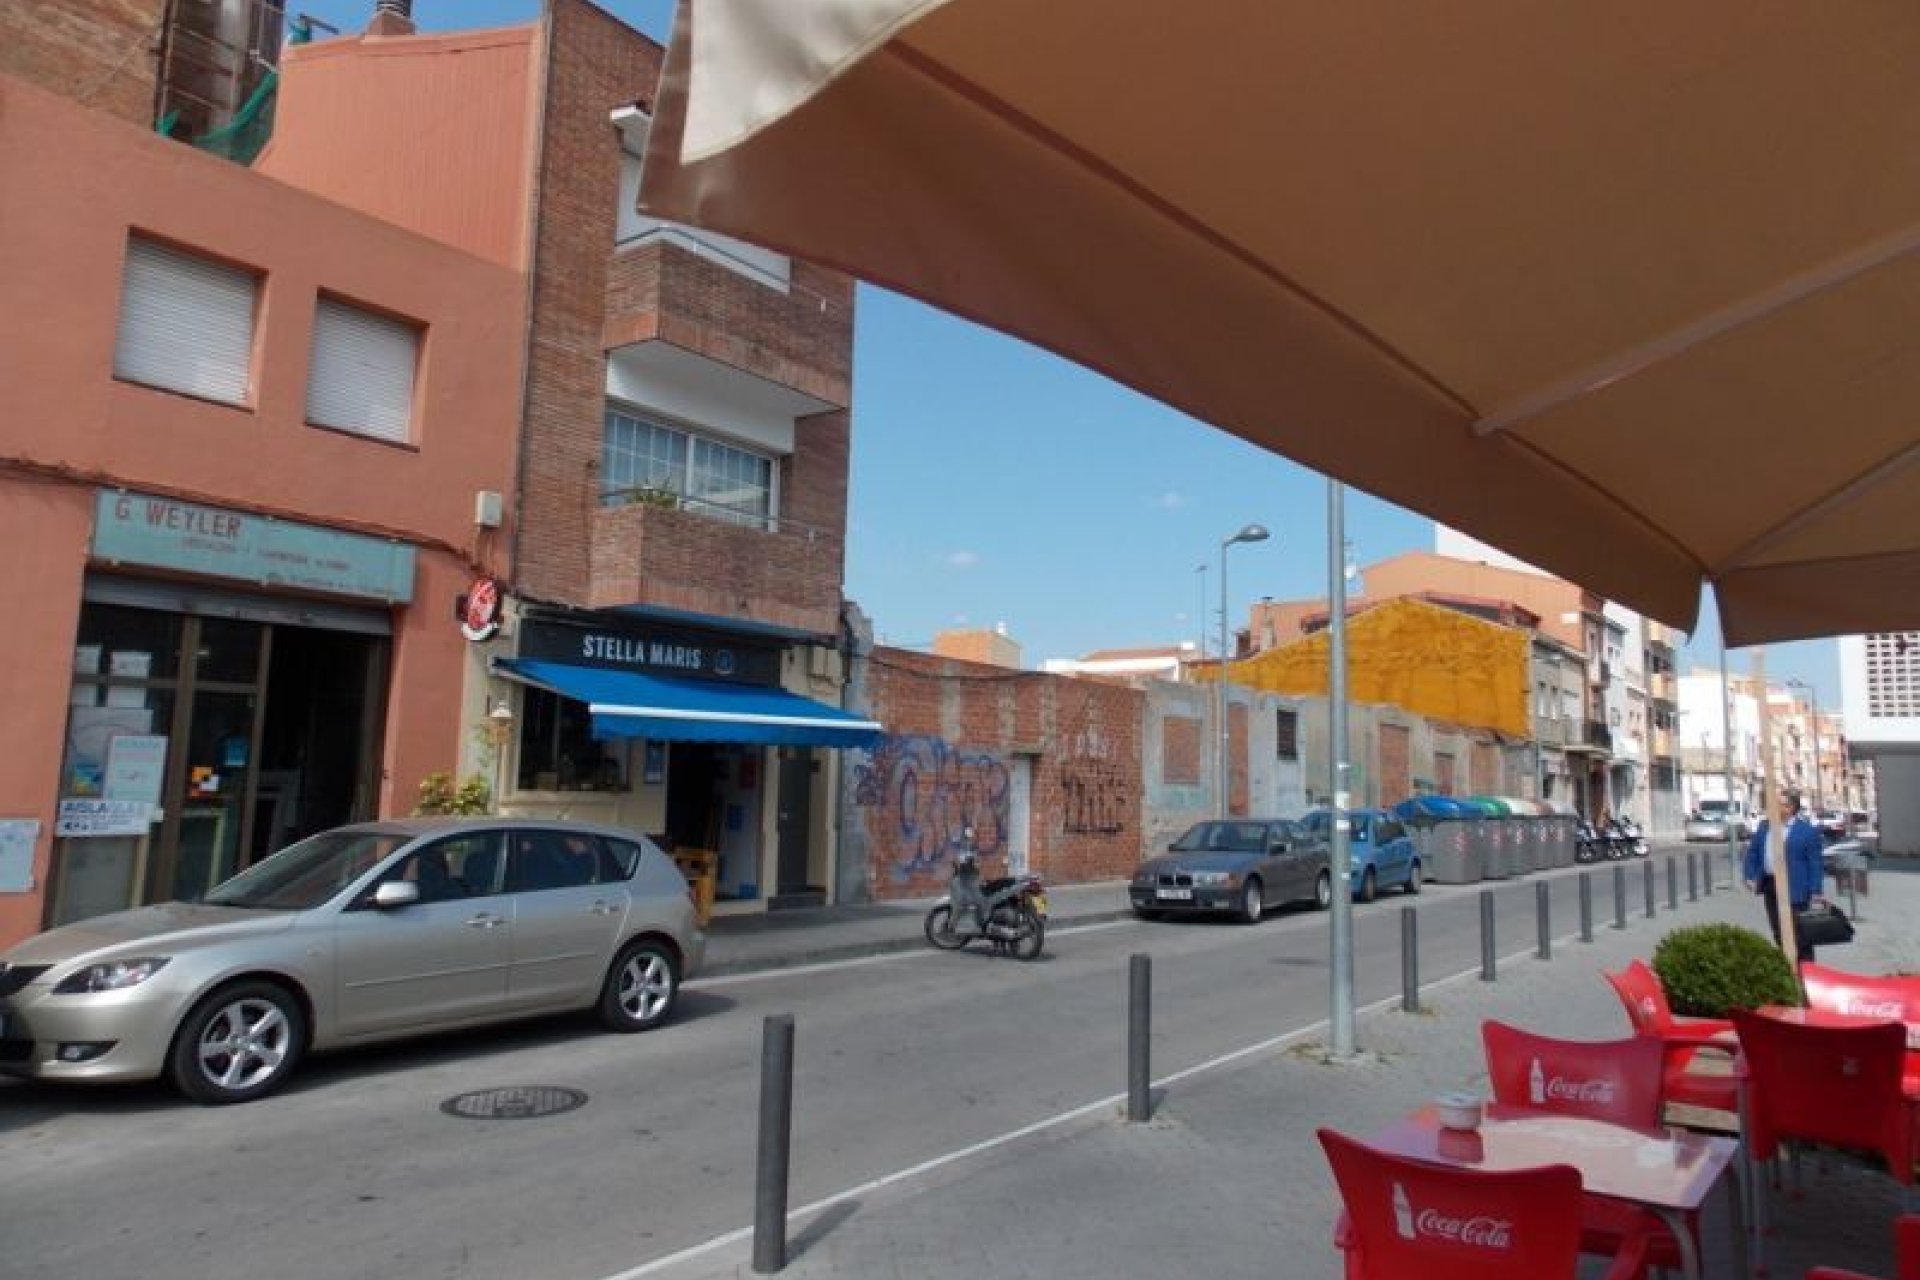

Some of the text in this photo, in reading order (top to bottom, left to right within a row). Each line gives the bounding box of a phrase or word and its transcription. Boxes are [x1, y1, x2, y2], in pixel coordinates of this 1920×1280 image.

[146, 500, 241, 539] WEYLER
[583, 634, 702, 670] STELLA MARIS
